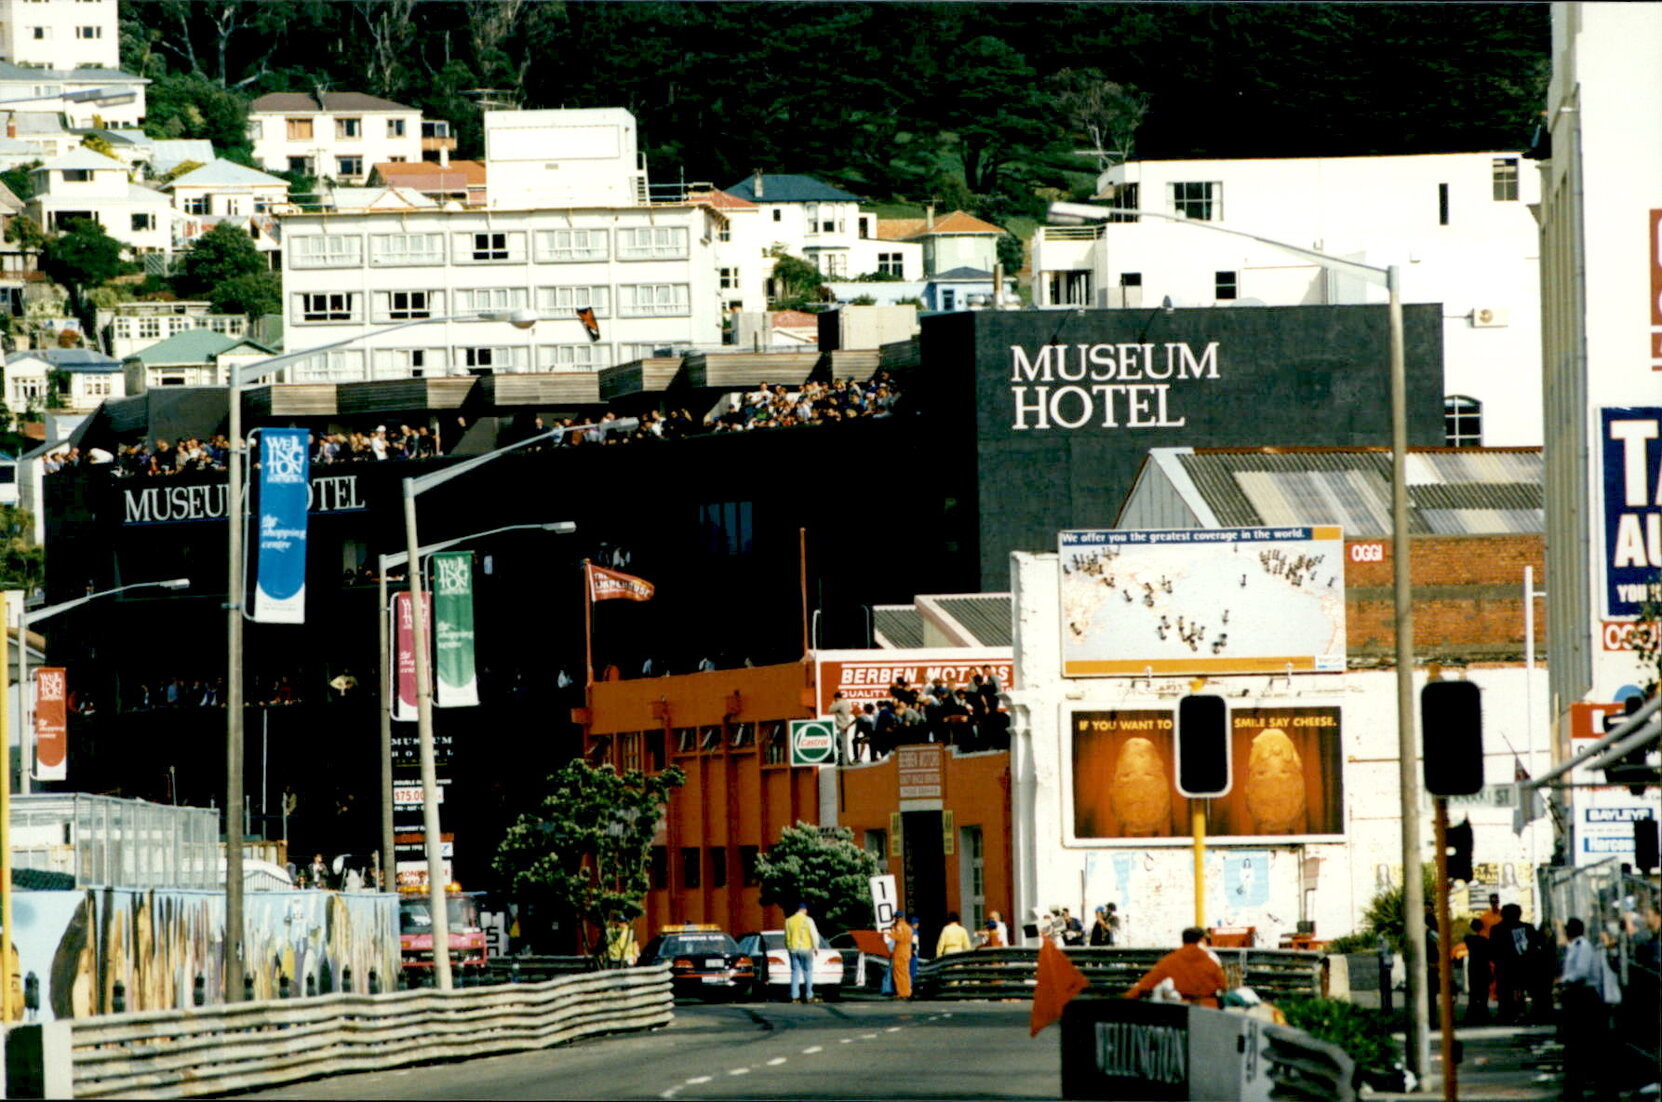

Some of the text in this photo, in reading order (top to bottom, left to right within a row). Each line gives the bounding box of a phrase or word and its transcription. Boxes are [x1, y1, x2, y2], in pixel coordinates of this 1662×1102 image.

[1010, 342, 1220, 382] MUSEUM
[1011, 384, 1185, 429] HOTEL
[1610, 420, 1661, 506] T
[306, 475, 365, 513] TEL
[1062, 527, 1305, 544] We offer you the greatest coverage in the world.
[1351, 544, 1383, 562] OGGI
[1616, 584, 1648, 603] YOU
[841, 666, 1009, 685] BERBEN MOTS
[1078, 716, 1337, 731] IF YOU WANT TO SMILE SAY CHEESE.
[391, 736, 452, 746] MUSUM
[391, 748, 454, 758] HOEL
[878, 881, 893, 931] 10
